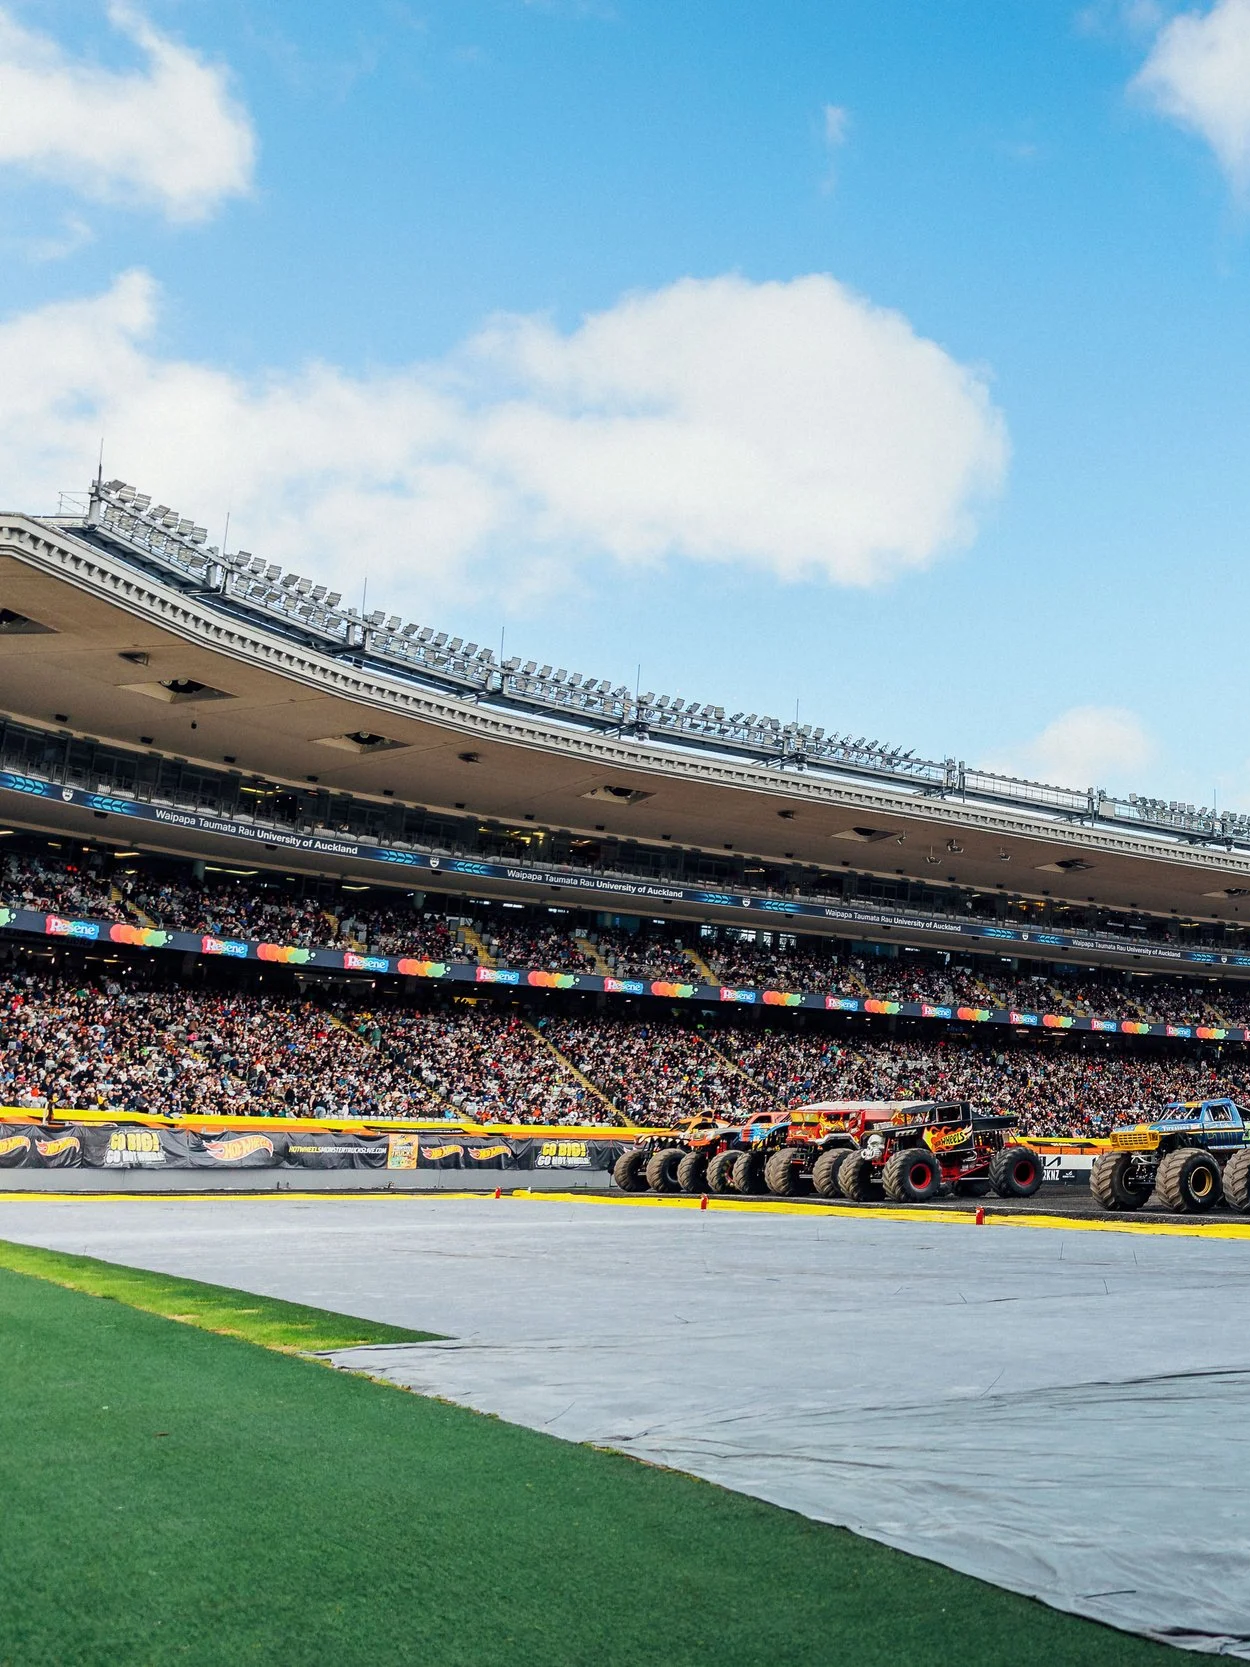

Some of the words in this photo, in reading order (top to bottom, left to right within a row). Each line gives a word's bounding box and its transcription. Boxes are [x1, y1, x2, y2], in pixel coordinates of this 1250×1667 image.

[155, 809, 196, 826] Waipapa
[199, 817, 236, 834] Taumata
[238, 826, 255, 837] Rau
[257, 829, 301, 848] University
[302, 839, 312, 848] of
[314, 840, 358, 854] Auckland
[507, 869, 543, 881] Waipapa
[545, 873, 578, 885] Taumata
[579, 878, 595, 887] Rau
[596, 881, 636, 893] University
[637, 886, 646, 894] of
[647, 888, 683, 898] Auckland
[825, 909, 852, 919] Waipapa
[853, 912, 880, 922] Taumata
[881, 915, 892, 923] Rau
[893, 917, 925, 928] University
[934, 922, 961, 931] Auckland
[50, 919, 95, 935] Resene
[206, 938, 245, 954] Resene
[1126, 946, 1151, 955] University
[1158, 949, 1181, 957] Auckland
[348, 955, 386, 968] Resene
[480, 968, 516, 982] Resene
[607, 980, 641, 991] Resene
[723, 989, 753, 1000] Resene
[828, 998, 856, 1008] Resene
[924, 1006, 948, 1016] Resene
[1012, 1013, 1035, 1023] Resene
[1093, 1020, 1114, 1029] Resene
[1168, 1027, 1188, 1035] Resene
[111, 1133, 126, 1150] GO
[127, 1133, 160, 1152] BIG!
[941, 1132, 965, 1145] WHEELS
[542, 1142, 556, 1156] GO
[558, 1142, 586, 1156] BIG!
[537, 1156, 551, 1166] GO
